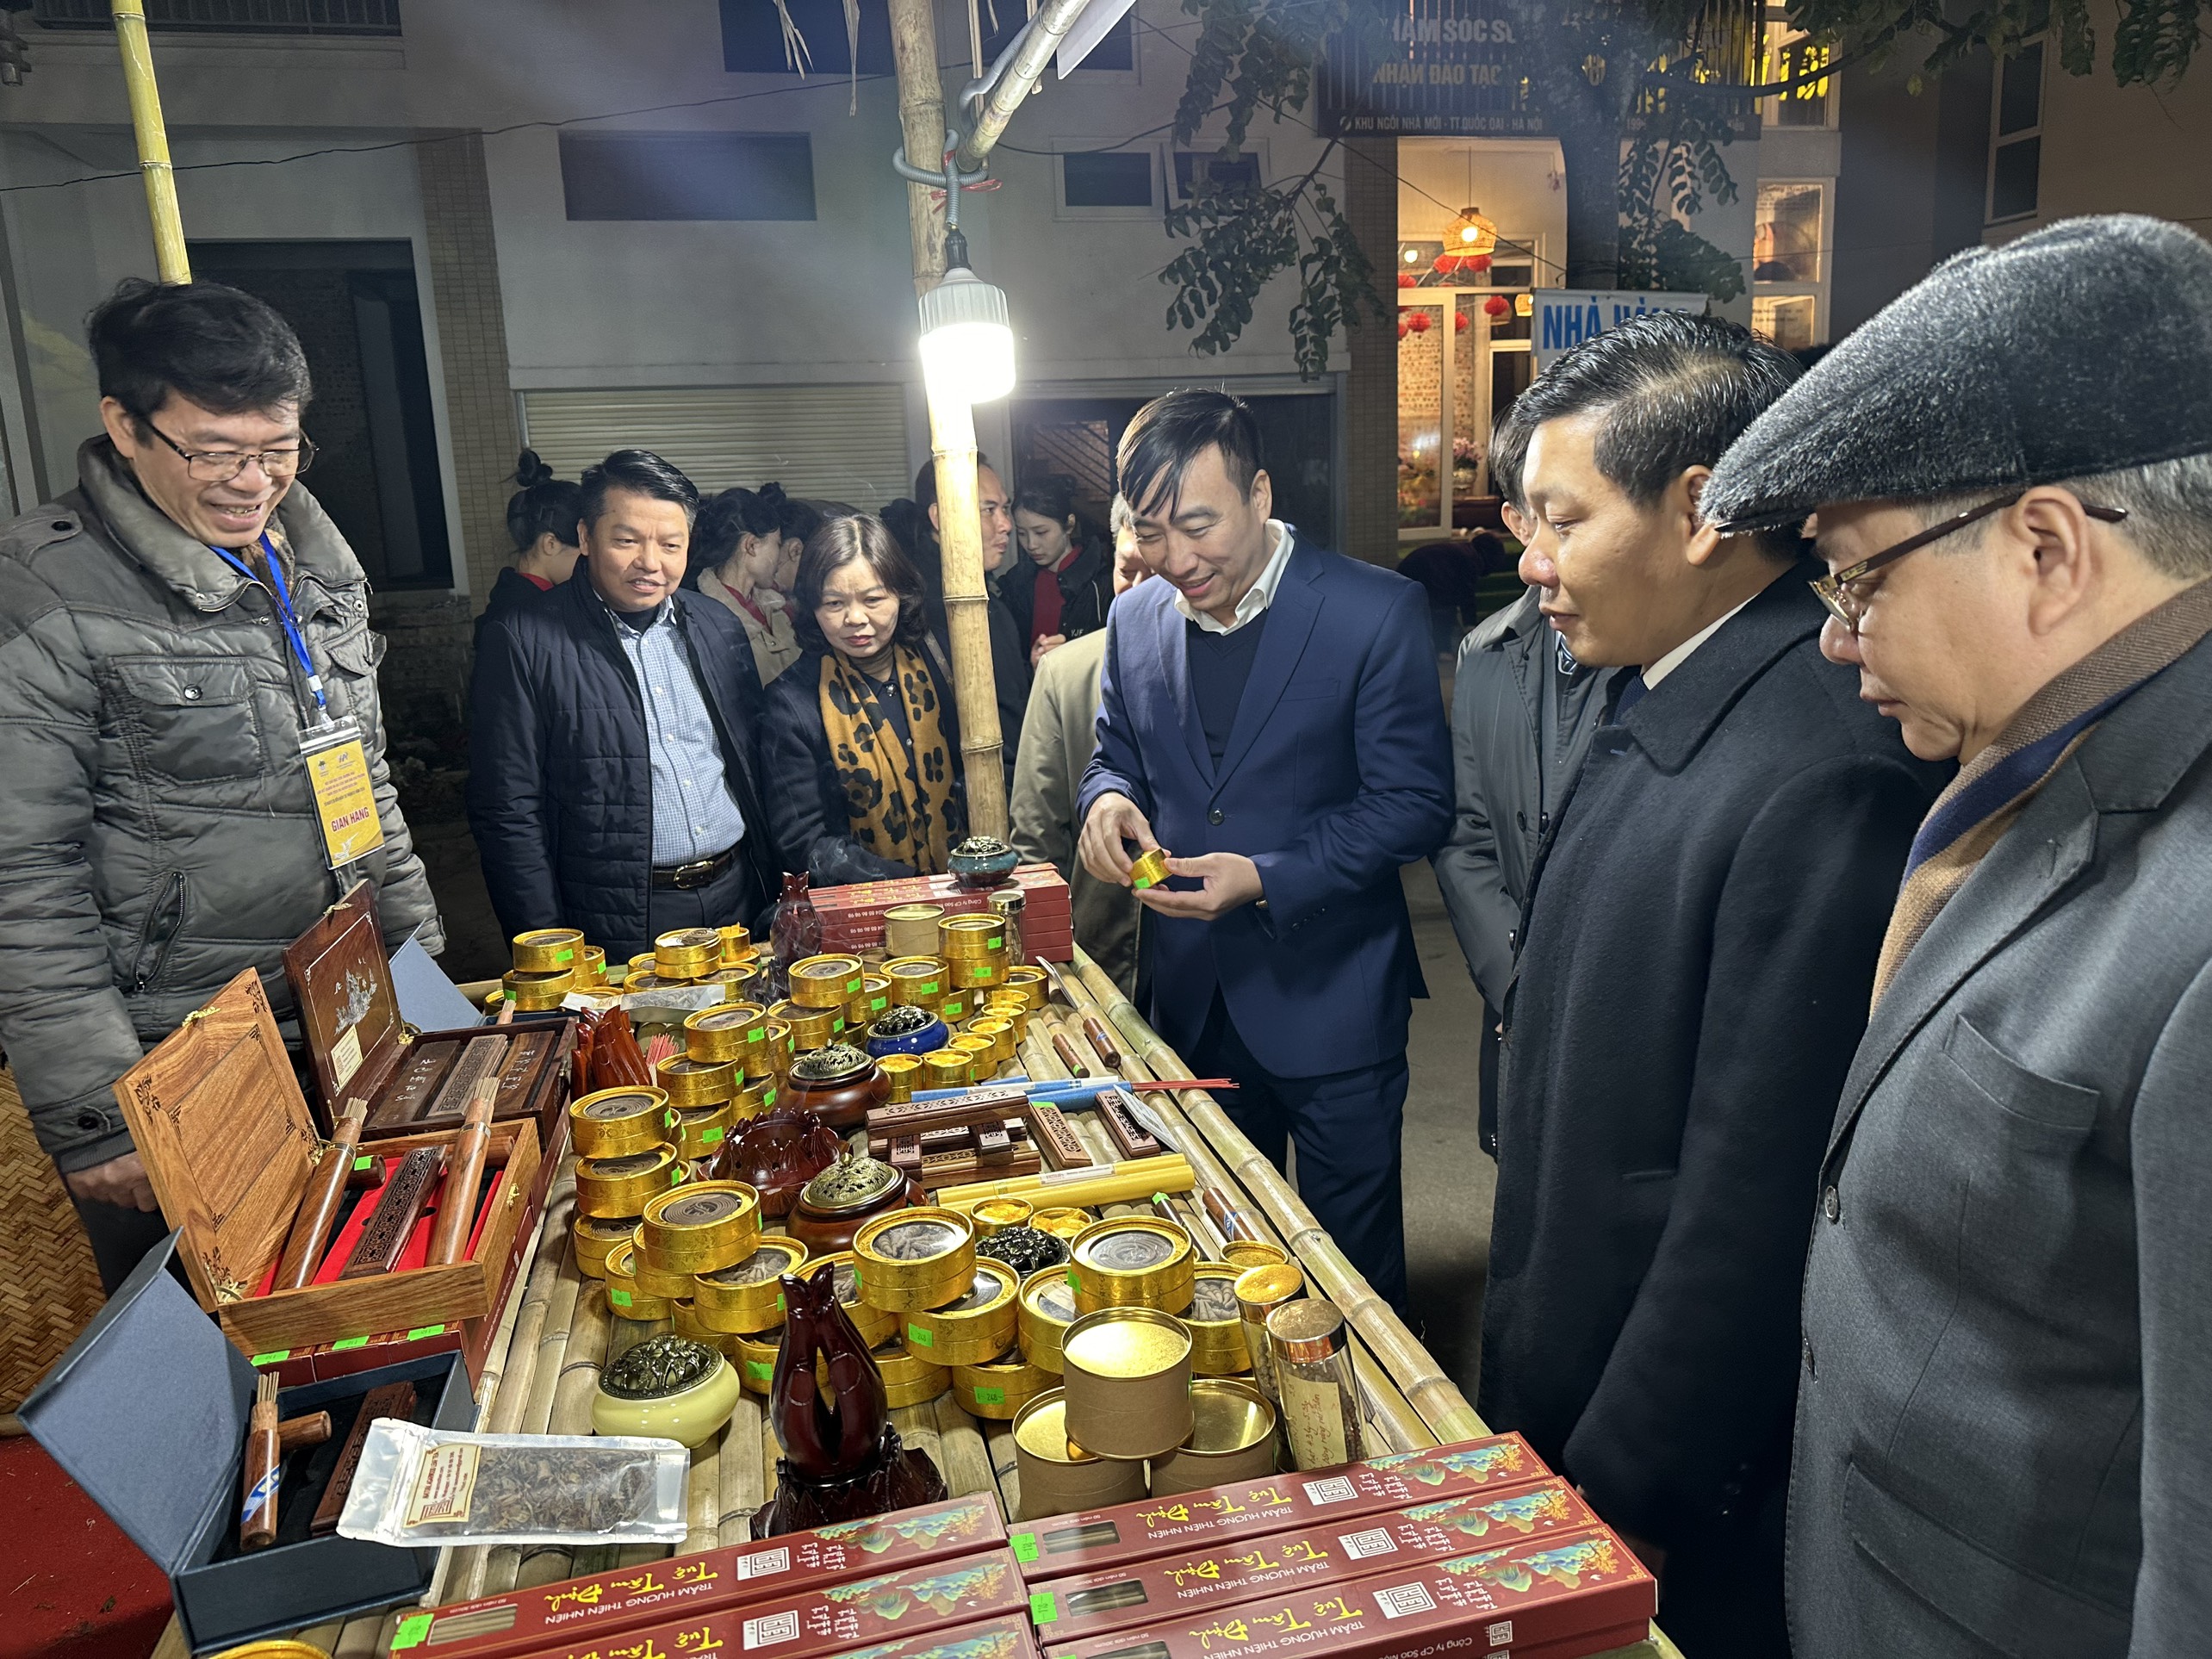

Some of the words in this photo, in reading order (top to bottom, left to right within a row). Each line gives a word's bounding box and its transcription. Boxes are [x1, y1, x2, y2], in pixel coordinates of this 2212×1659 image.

[1443, 13, 1487, 42] SÓC
[1373, 59, 1423, 88] NHẬN
[1429, 59, 1464, 84] ĐÀO
[1355, 117, 1373, 129] KHU
[1402, 115, 1421, 129] NHÀ
[1425, 115, 1441, 129] MỚI
[1512, 115, 1524, 129] HÀ
[1528, 115, 1542, 130] NỘI
[1544, 295, 1601, 350] NHÀ
[332, 816, 349, 831] GIAN
[986, 1393, 998, 1401] 248
[1249, 1488, 1292, 1506] Tuệ
[1194, 1495, 1246, 1515] Tâm
[1262, 1506, 1293, 1517] TRẦM
[1136, 1504, 1189, 1527] Định
[1216, 1513, 1259, 1525] HƯƠNG
[1148, 1526, 1182, 1538] NHIÊN
[1184, 1520, 1215, 1532] THIÊN
[1282, 1541, 1328, 1562] Tuệ
[1224, 1550, 1279, 1572] Tâm
[1296, 1562, 1329, 1574] TRẦM
[673, 1562, 718, 1583] Tuệ
[1164, 1560, 1220, 1586] Định
[1250, 1569, 1295, 1582] HƯƠNG
[611, 1573, 664, 1595] Tâm
[678, 1582, 712, 1594] TRẦM
[1215, 1577, 1247, 1590] THIÊN
[544, 1584, 603, 1612] Định
[626, 1590, 674, 1606] HƯƠNG
[1177, 1585, 1213, 1599] NHIÊN
[587, 1602, 622, 1615] THIÊN
[1314, 1597, 1363, 1620] Tuệ
[545, 1610, 585, 1624] NHIÊN
[1252, 1608, 1311, 1633] Tâm
[1189, 1619, 1249, 1649] Định
[1329, 1620, 1364, 1634] TRẦM
[674, 1627, 724, 1653] Tuệ
[1280, 1629, 1327, 1645] HƯƠNG
[1447, 1637, 1472, 1650] Công
[1244, 1639, 1278, 1653] THIÊN
[1420, 1646, 1434, 1656] CP
